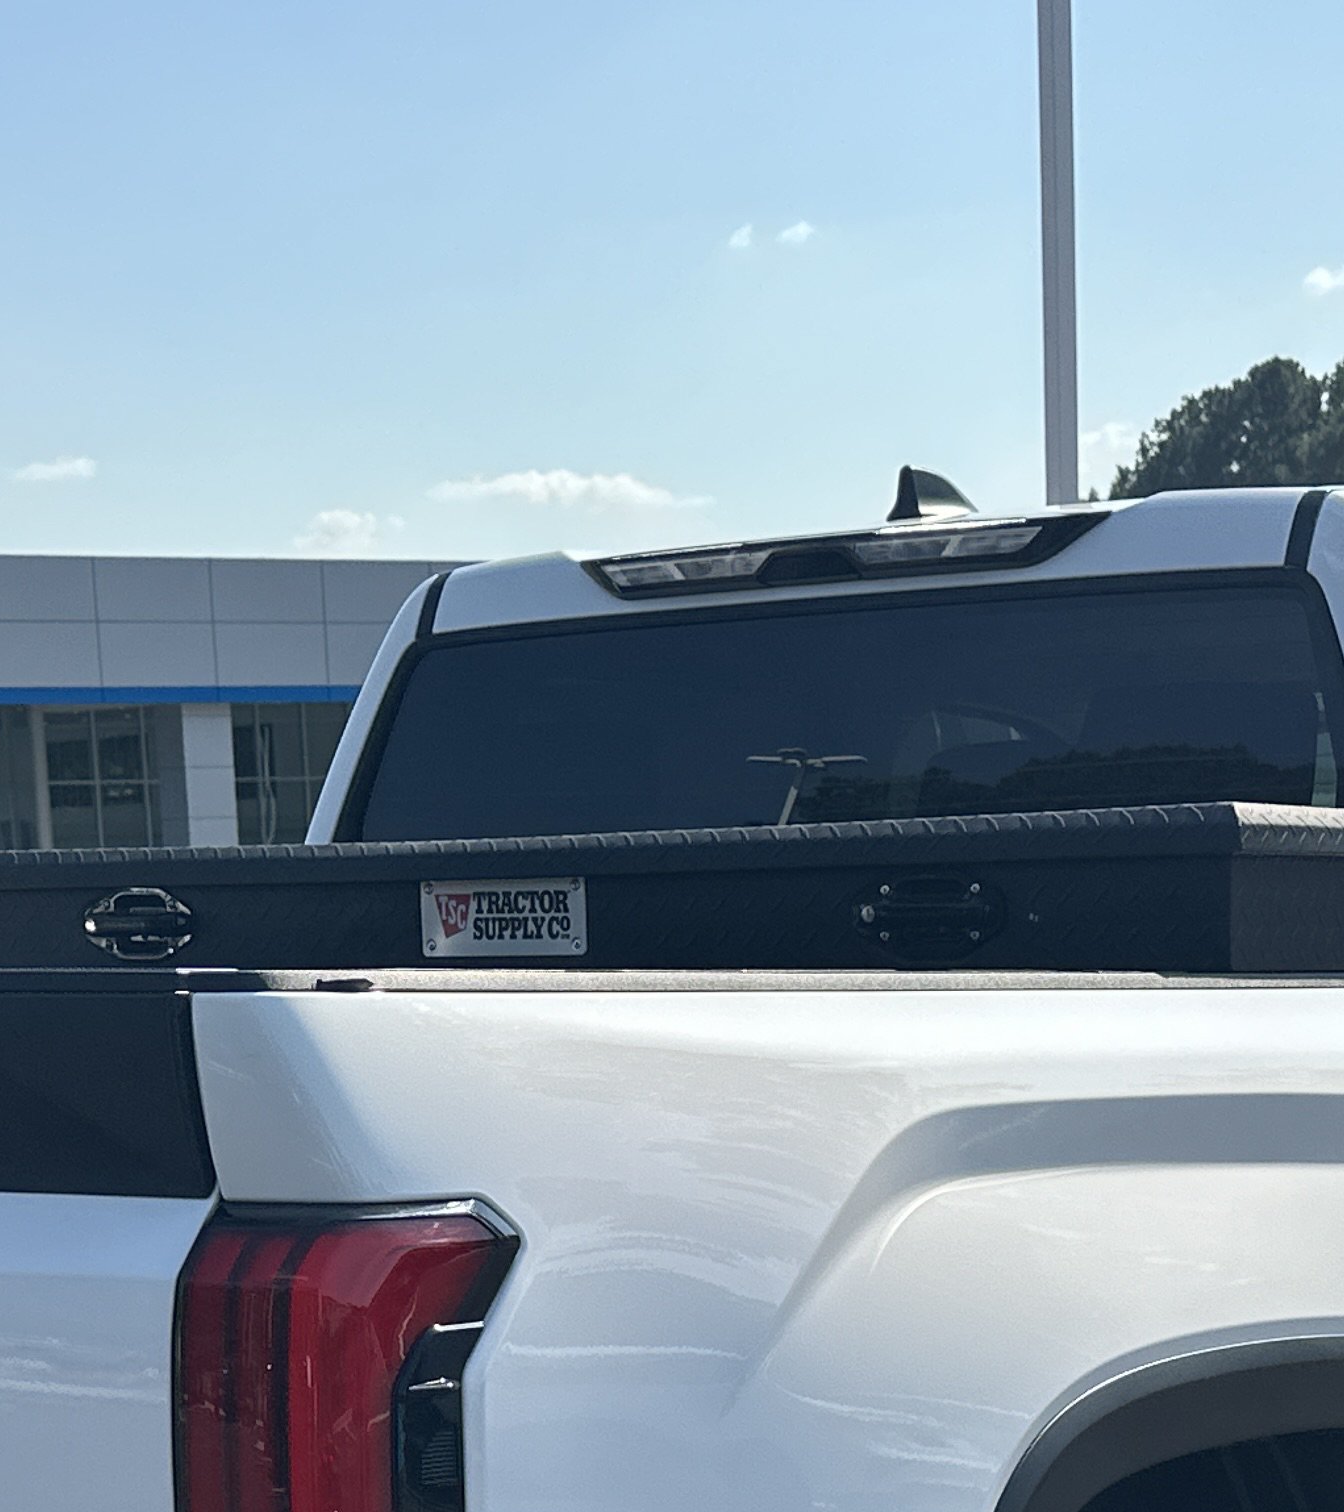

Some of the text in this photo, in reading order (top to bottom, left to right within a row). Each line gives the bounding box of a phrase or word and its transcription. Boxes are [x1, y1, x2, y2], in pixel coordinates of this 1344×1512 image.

[439, 896, 466, 929] TSC
[472, 890, 569, 915] TRACTOR
[472, 917, 545, 940] SUPPLY
